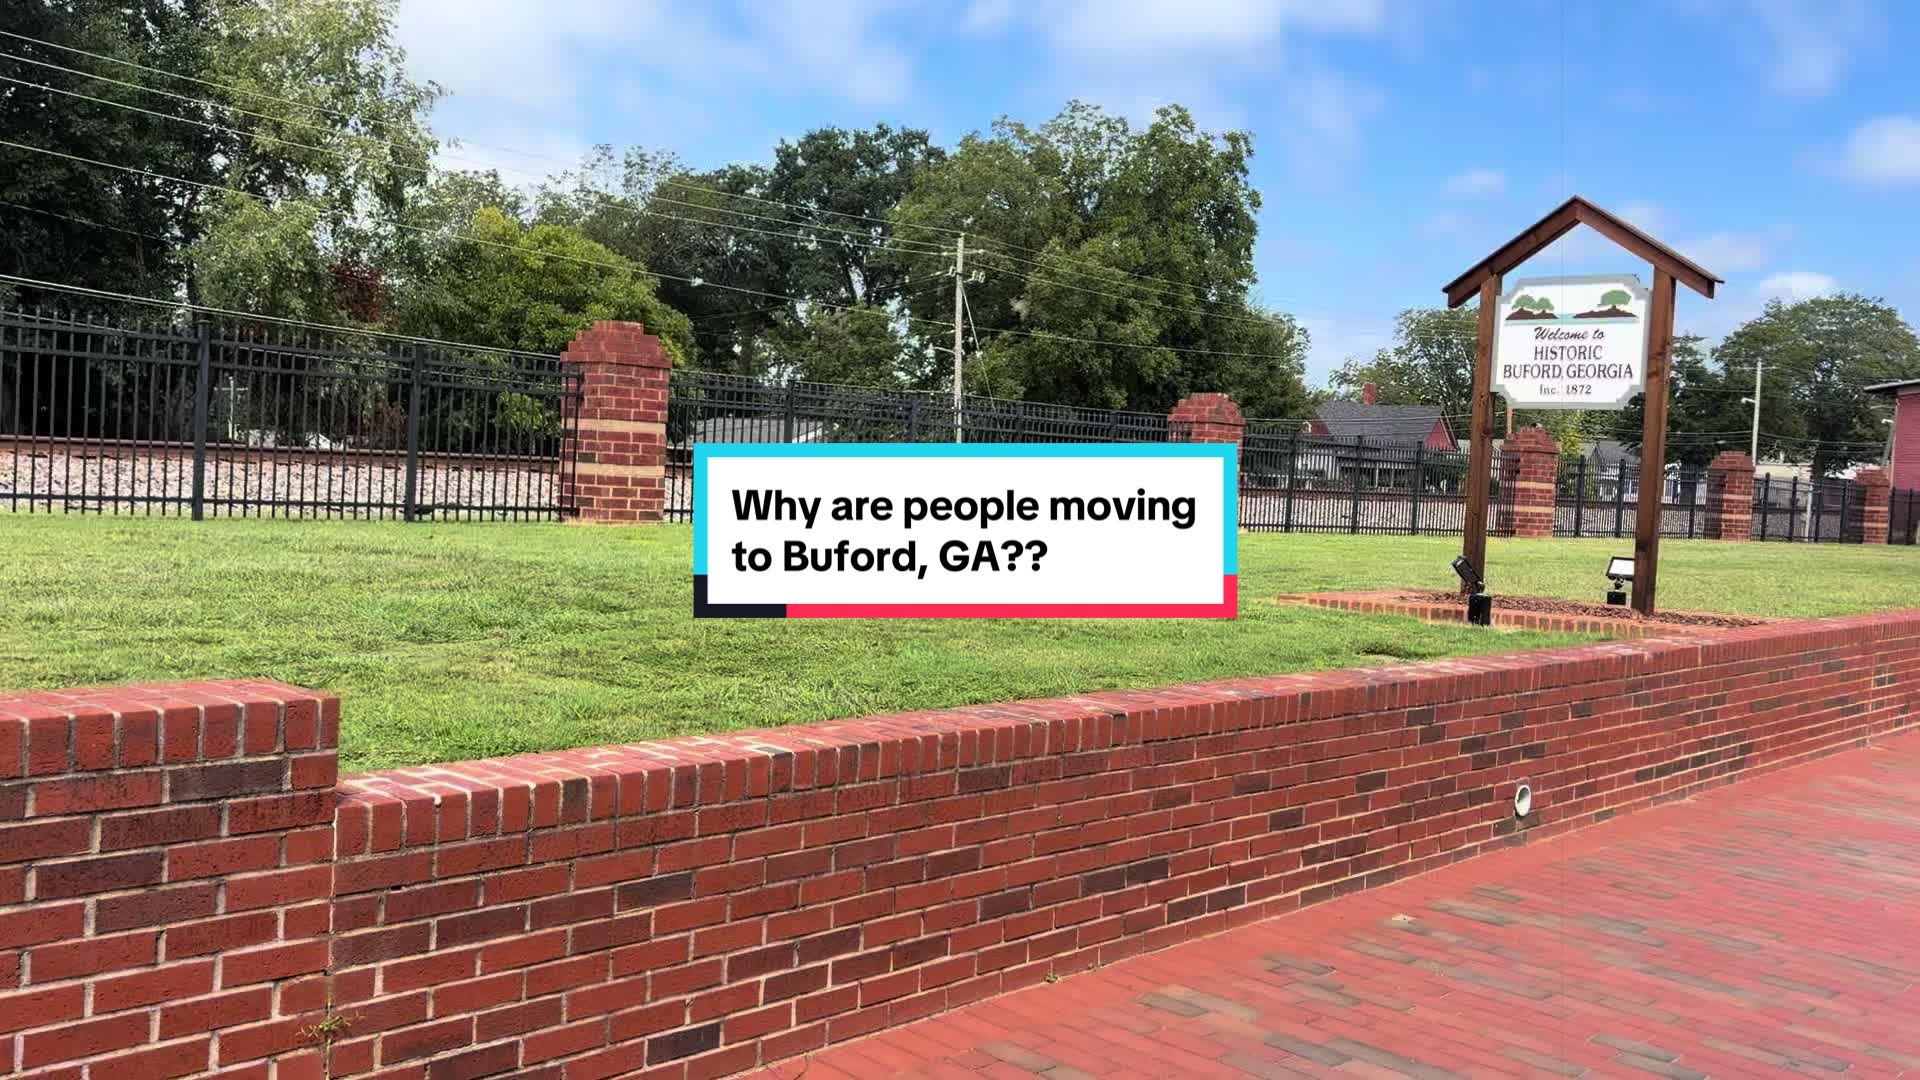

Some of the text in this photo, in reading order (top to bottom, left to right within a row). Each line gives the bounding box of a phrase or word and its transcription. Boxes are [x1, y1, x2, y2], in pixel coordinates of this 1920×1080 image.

[1534, 326, 1605, 340] Welcome to
[1533, 345, 1603, 361] HISTORIC
[1566, 363, 1633, 379] GEORGIA
[1539, 384, 1592, 395] Inc. 1872
